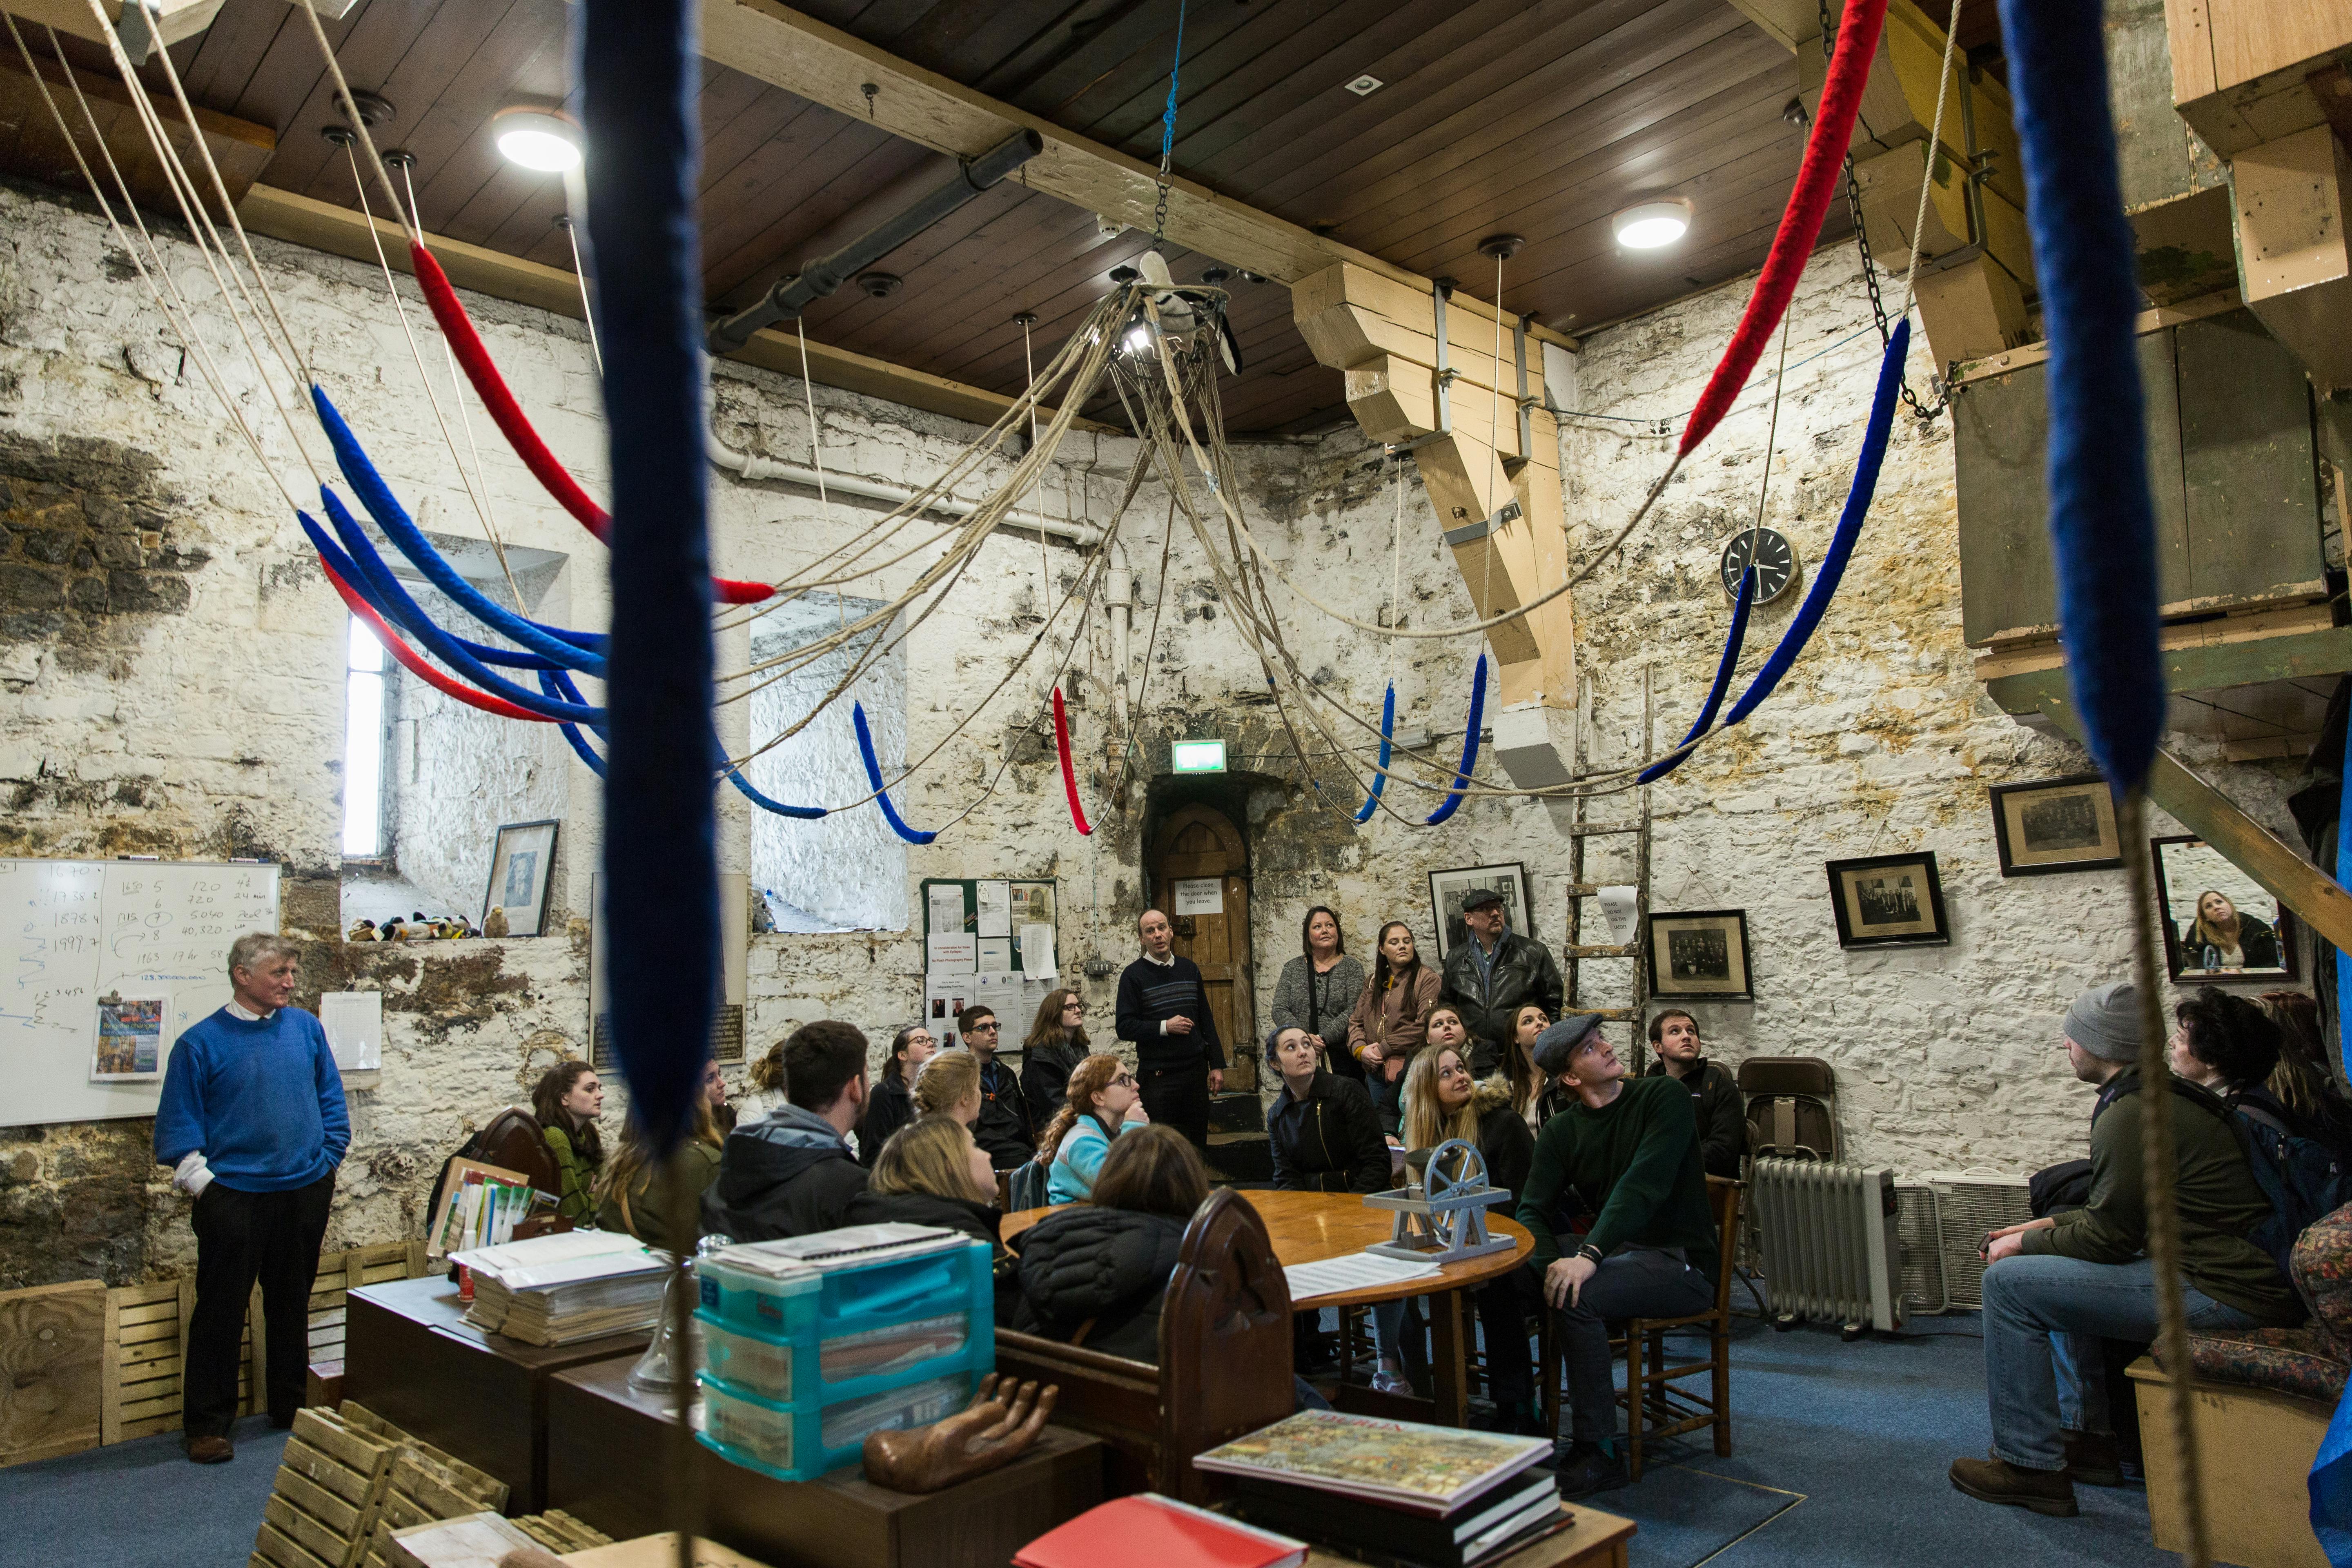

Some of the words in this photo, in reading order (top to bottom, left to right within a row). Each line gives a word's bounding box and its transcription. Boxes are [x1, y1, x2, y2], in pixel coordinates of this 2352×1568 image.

[154, 880, 164, 893] 5
[193, 881, 220, 891] 120
[155, 899, 161, 909] 6
[188, 895, 213, 904] 720
[190, 910, 224, 919] 5040
[153, 929, 160, 941] 8
